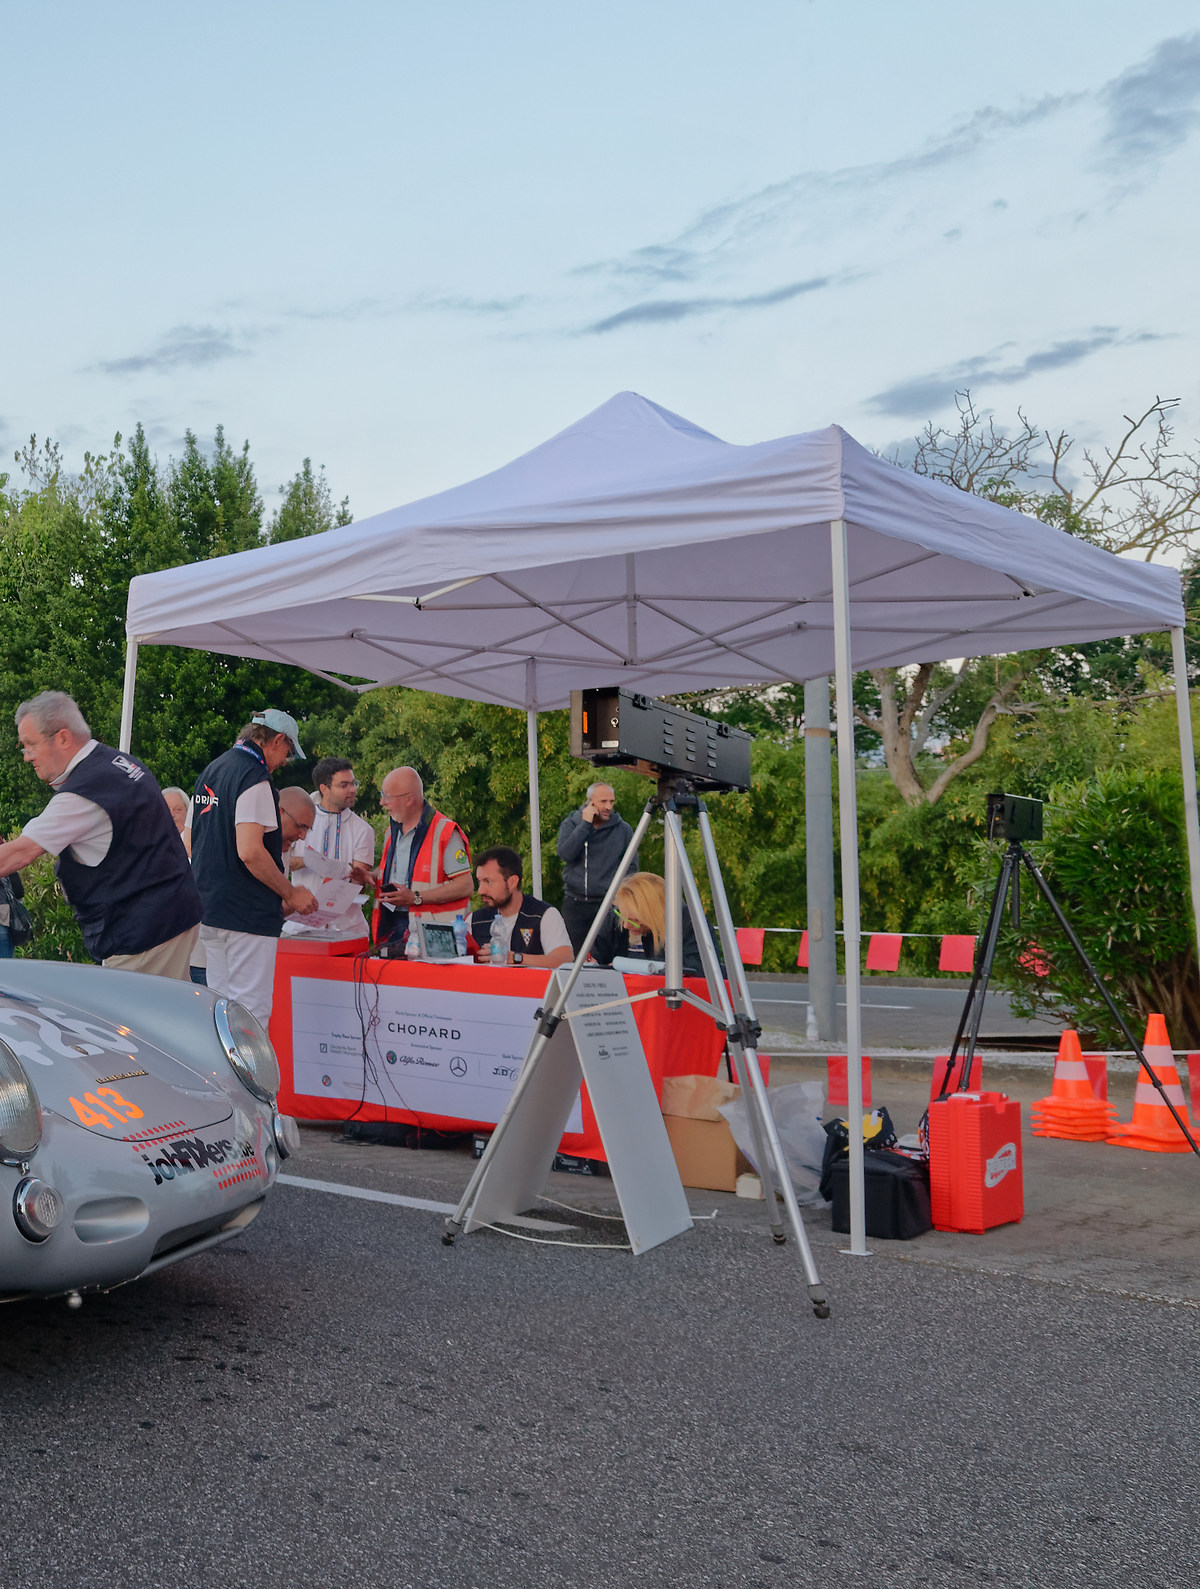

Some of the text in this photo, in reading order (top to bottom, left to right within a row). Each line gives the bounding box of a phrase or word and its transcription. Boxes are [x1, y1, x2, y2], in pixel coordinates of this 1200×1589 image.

[387, 1022, 461, 1040] CHOPARD
[399, 1055, 440, 1068] Alfa Romeo
[67, 1087, 145, 1130] 413
